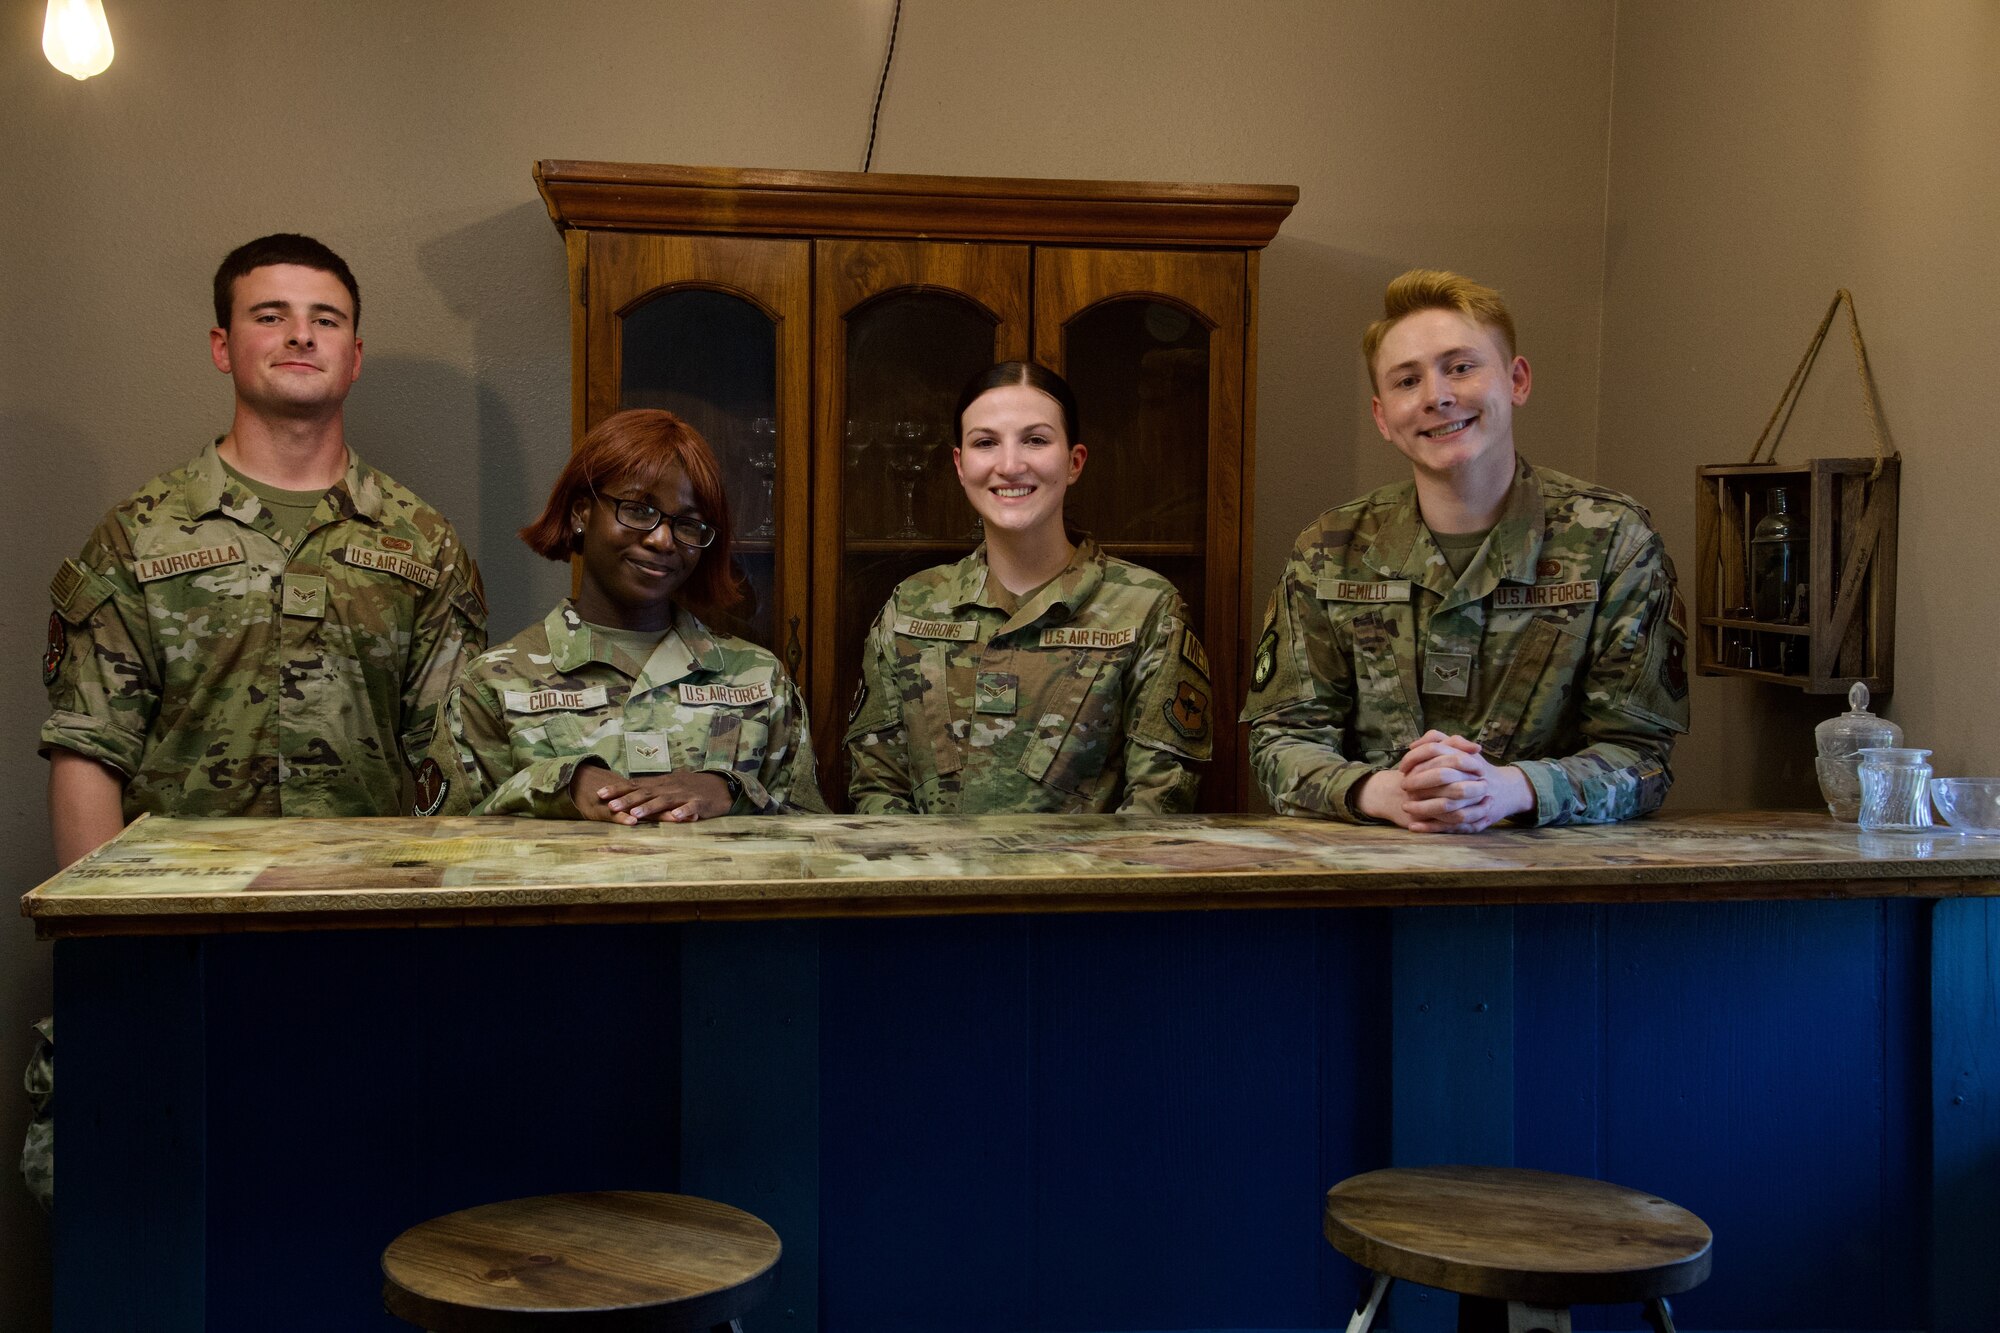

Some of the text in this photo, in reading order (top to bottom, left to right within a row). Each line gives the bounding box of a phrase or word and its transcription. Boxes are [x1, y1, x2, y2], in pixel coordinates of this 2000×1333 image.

[140, 545, 240, 579] LAURICELLA
[351, 549, 436, 586] U.S. AIR FORCE
[1337, 582, 1387, 600] DEMILLO
[1497, 582, 1593, 605] U.S. AIR FORCE
[908, 620, 962, 638] BURROWS
[1044, 628, 1131, 646] U.S. AIR FORCE
[529, 692, 584, 711] CUDJOE
[685, 683, 768, 703] U.S. AIR FORCE
